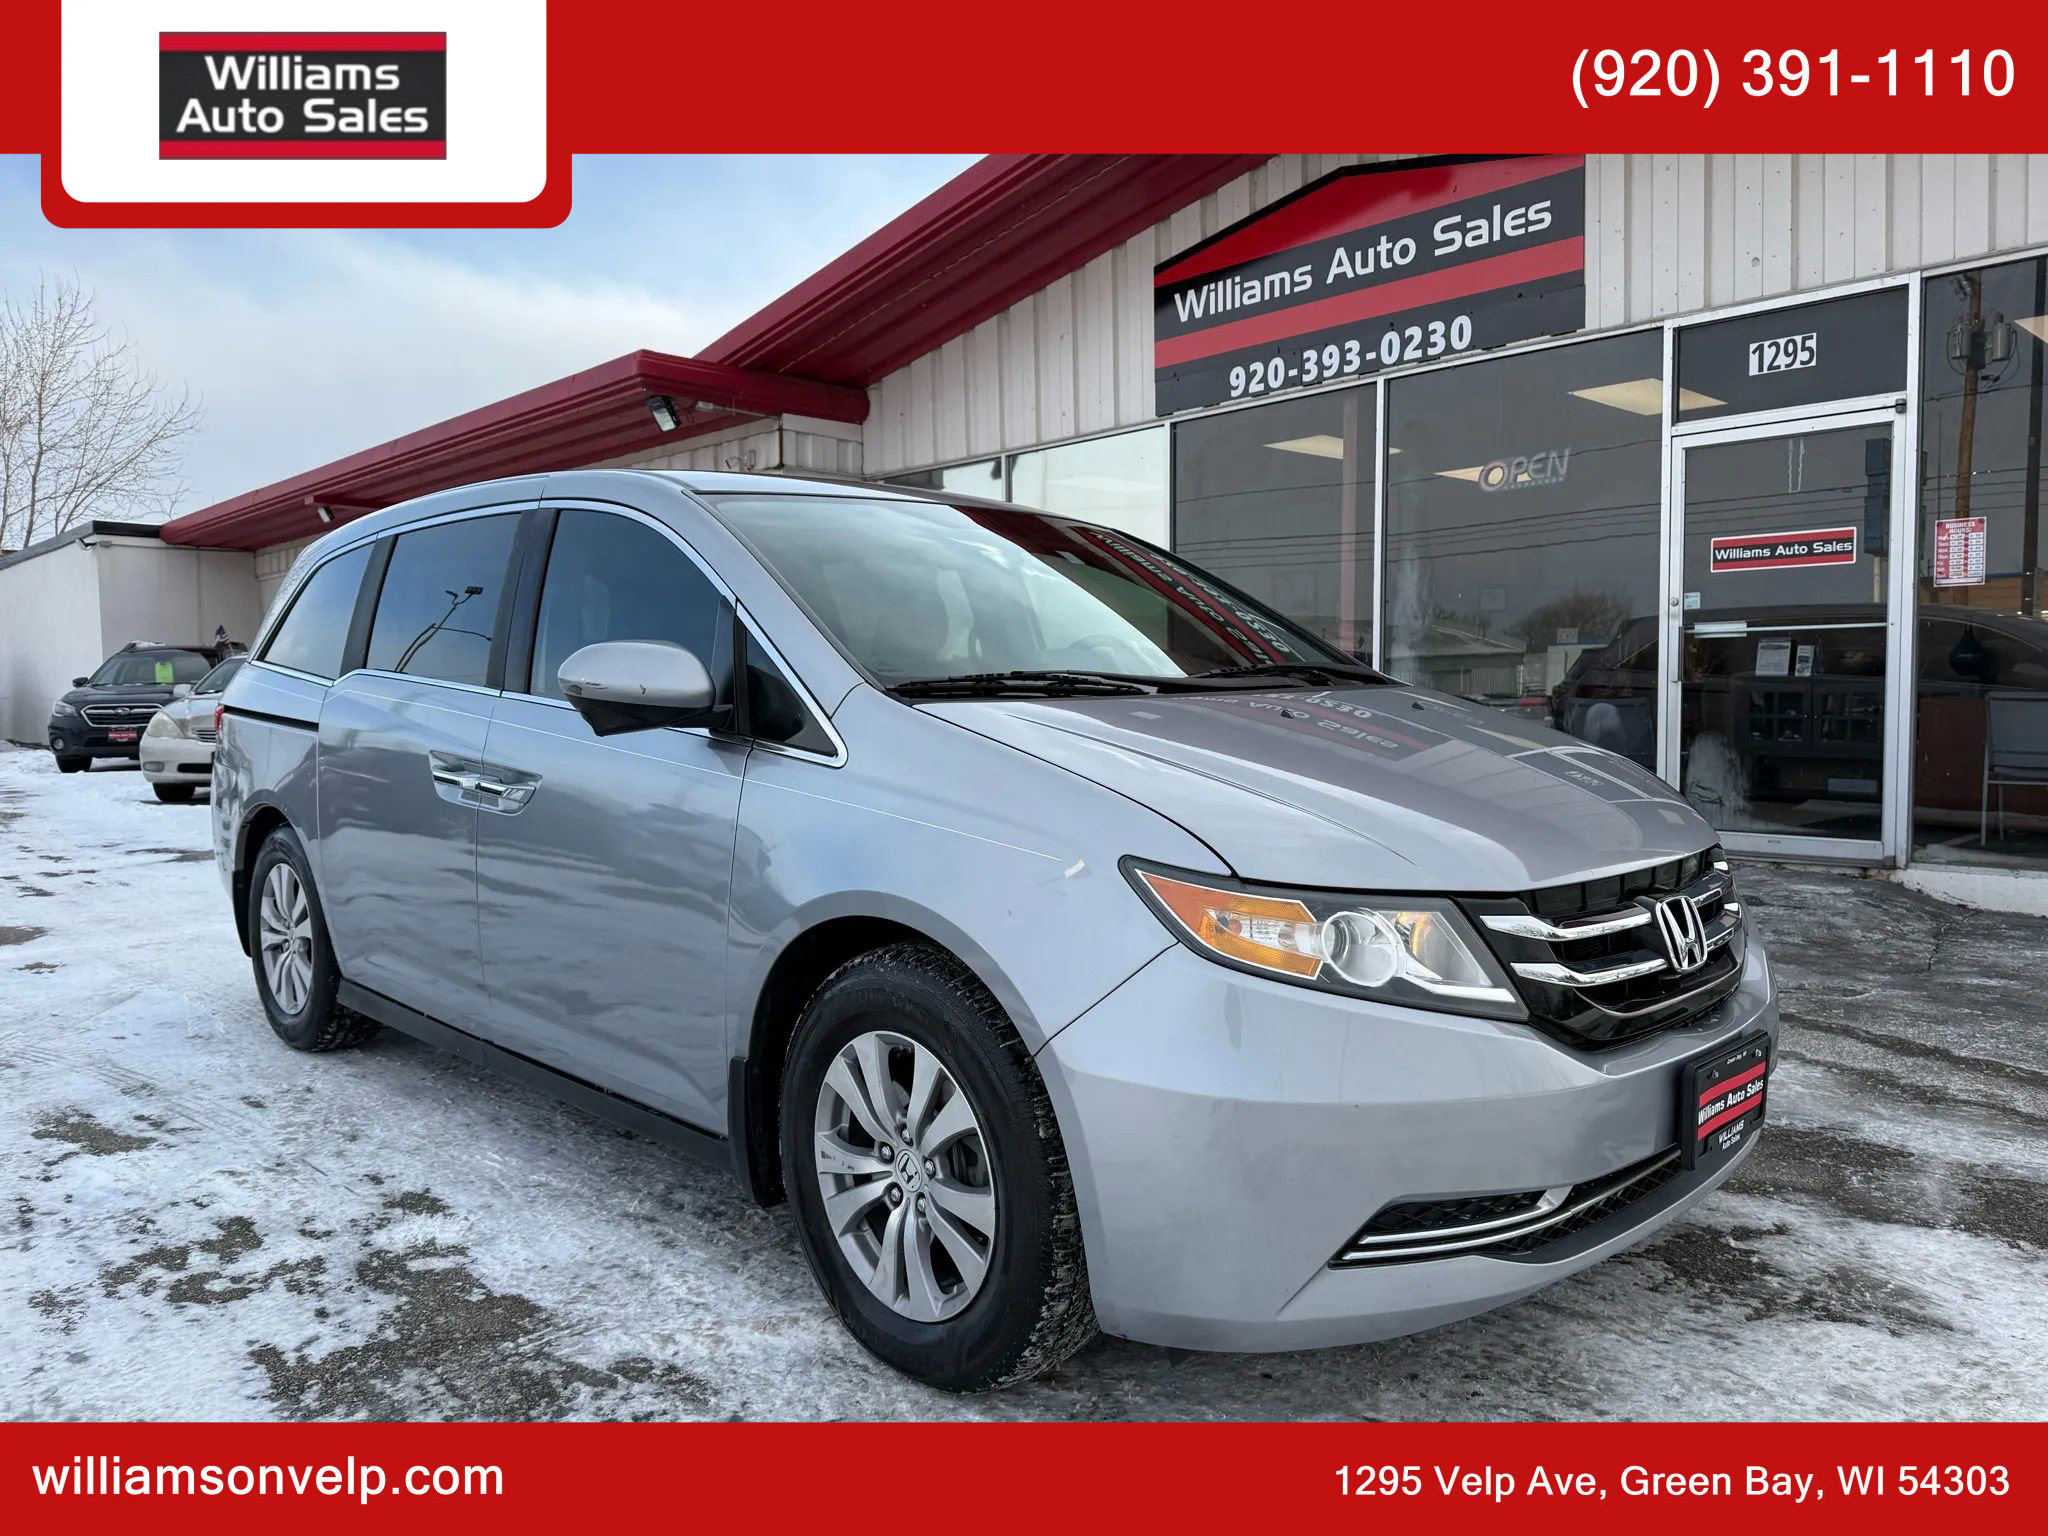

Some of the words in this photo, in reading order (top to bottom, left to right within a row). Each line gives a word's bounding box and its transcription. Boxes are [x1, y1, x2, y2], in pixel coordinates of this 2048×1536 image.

[1173, 263, 1313, 323] Williams
[1325, 234, 1417, 285] Auto
[1432, 199, 1553, 257] Sales
[1228, 315, 1473, 398] 920-393-0230
[1751, 334, 1815, 373] 1295
[1479, 447, 1571, 492] OPEN
[1714, 547, 1771, 561] Williams
[1775, 544, 1808, 556] Auto
[1812, 540, 1853, 553] Sales
[1698, 1098, 1725, 1125] Williams
[1726, 1089, 1745, 1107] Auto
[1746, 1079, 1764, 1097] Sales
